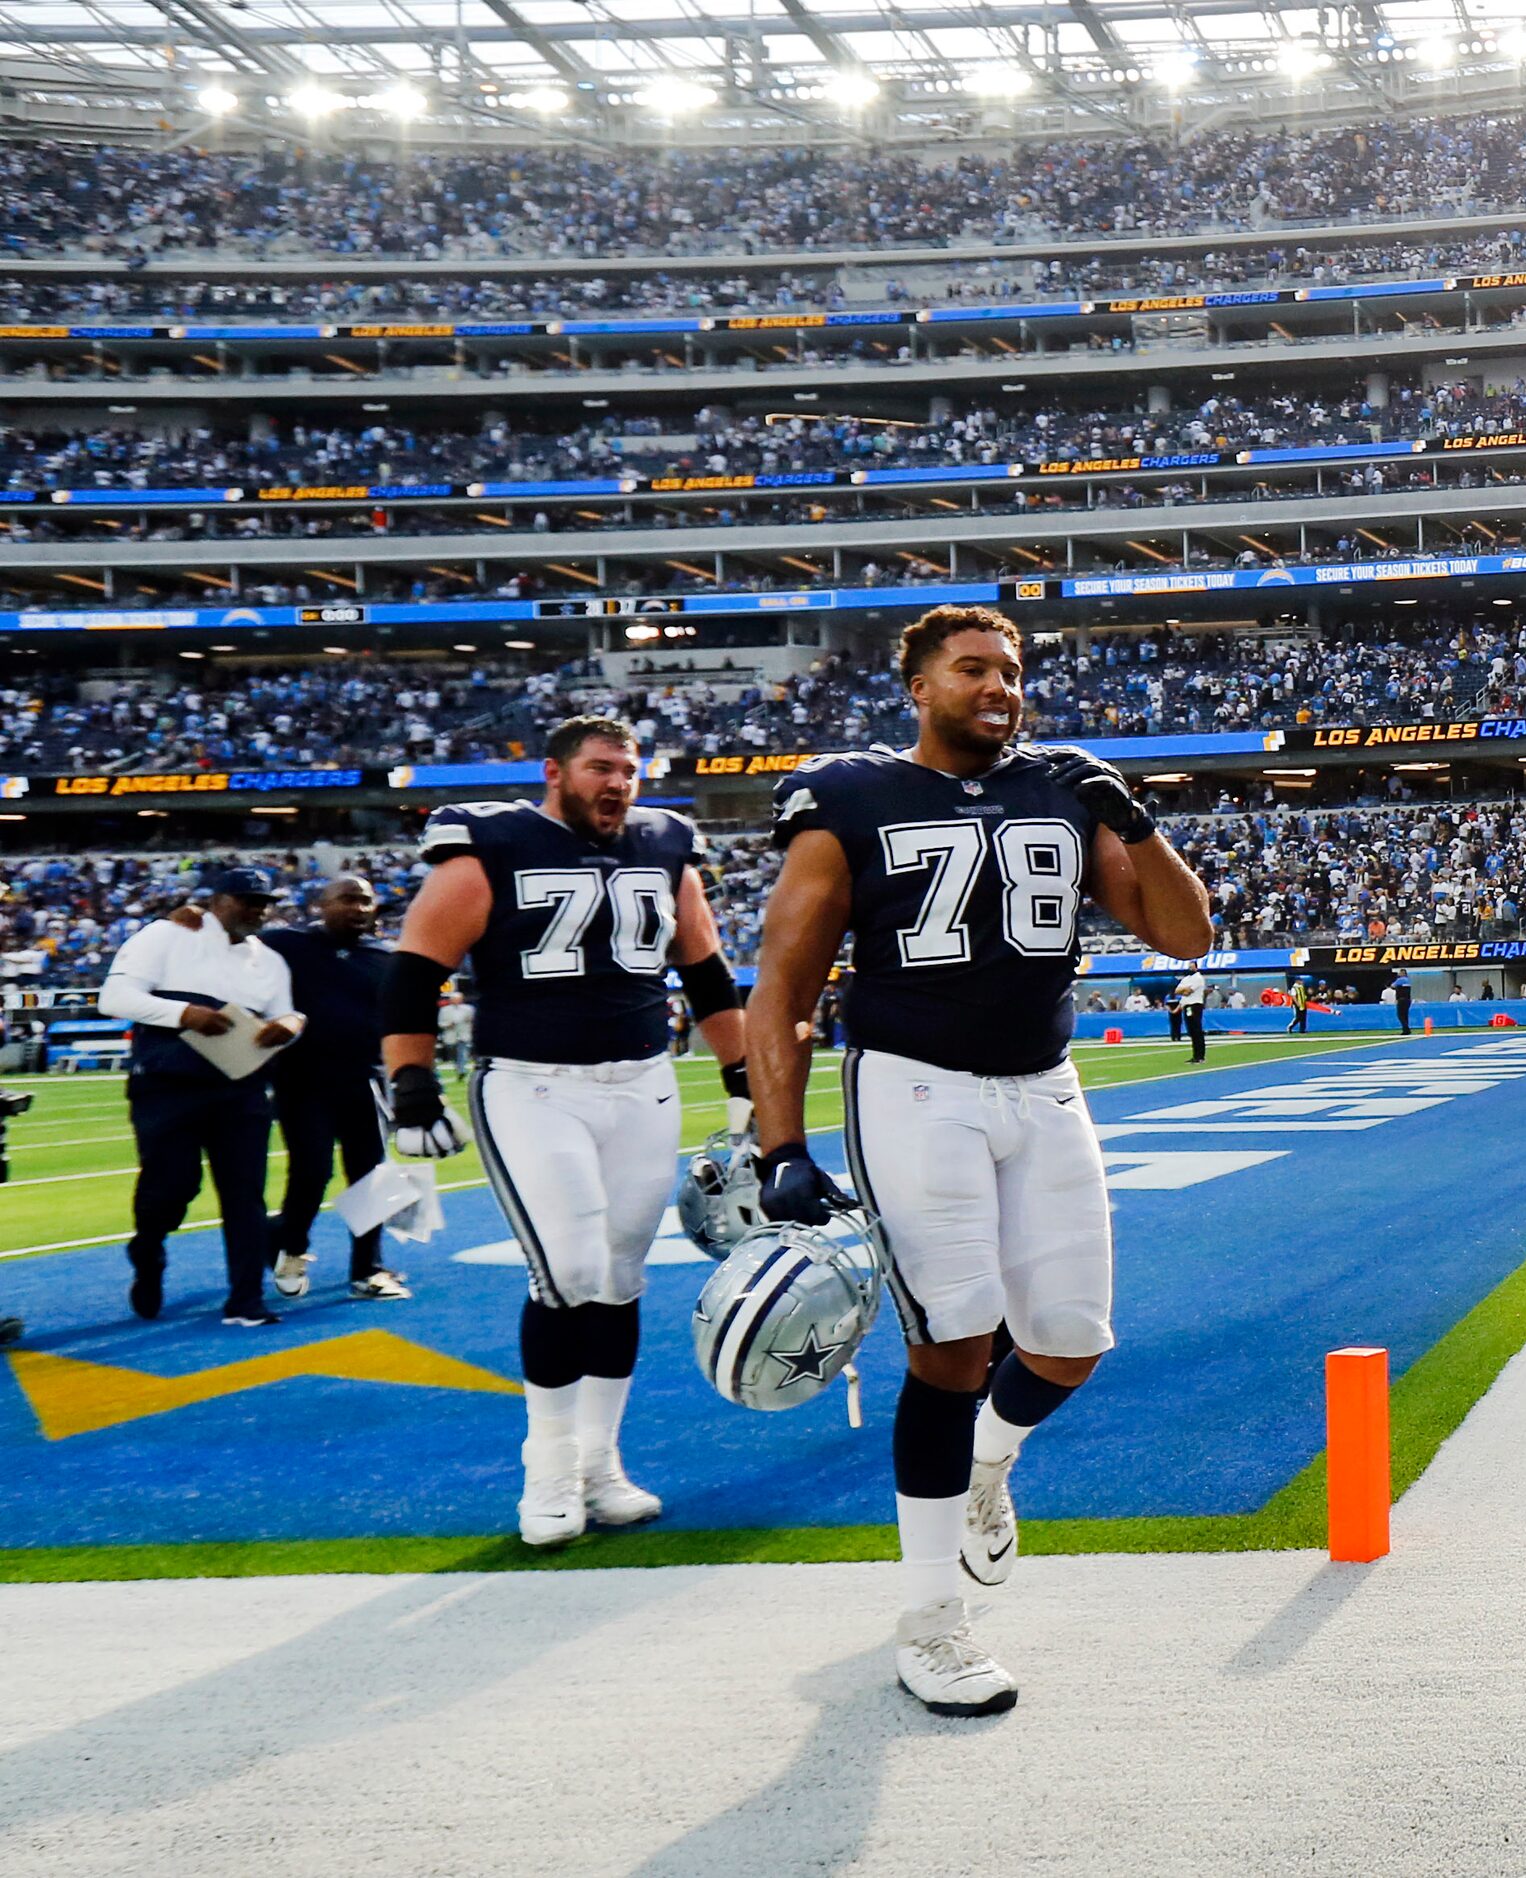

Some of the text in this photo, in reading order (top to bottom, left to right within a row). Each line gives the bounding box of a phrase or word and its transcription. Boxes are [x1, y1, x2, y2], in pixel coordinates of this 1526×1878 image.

[1473, 276, 1500, 288] LOS
[1109, 292, 1279, 312] LOS ANGELES CHARGERS
[1443, 438, 1473, 449] LOS
[1039, 453, 1220, 474] LOS ANGELES CHARGERS
[1316, 559, 1478, 582] SECURE YOUR SEASON TICKETS TODAY
[1018, 584, 1044, 598] 00
[1074, 573, 1235, 596] SECURE YOUR SEASON TICKETS TODAY
[1314, 729, 1360, 747] LOS
[1364, 722, 1478, 747] ANGELES
[696, 754, 813, 776] LOS ANGE
[56, 769, 362, 796] LOS ANGELES CHARGERS
[877, 817, 1083, 968] 78
[1462, 904, 1471, 916] 21
[513, 867, 678, 980] 70
[1335, 945, 1377, 963] LOS
[1379, 942, 1479, 964] ANGELES
